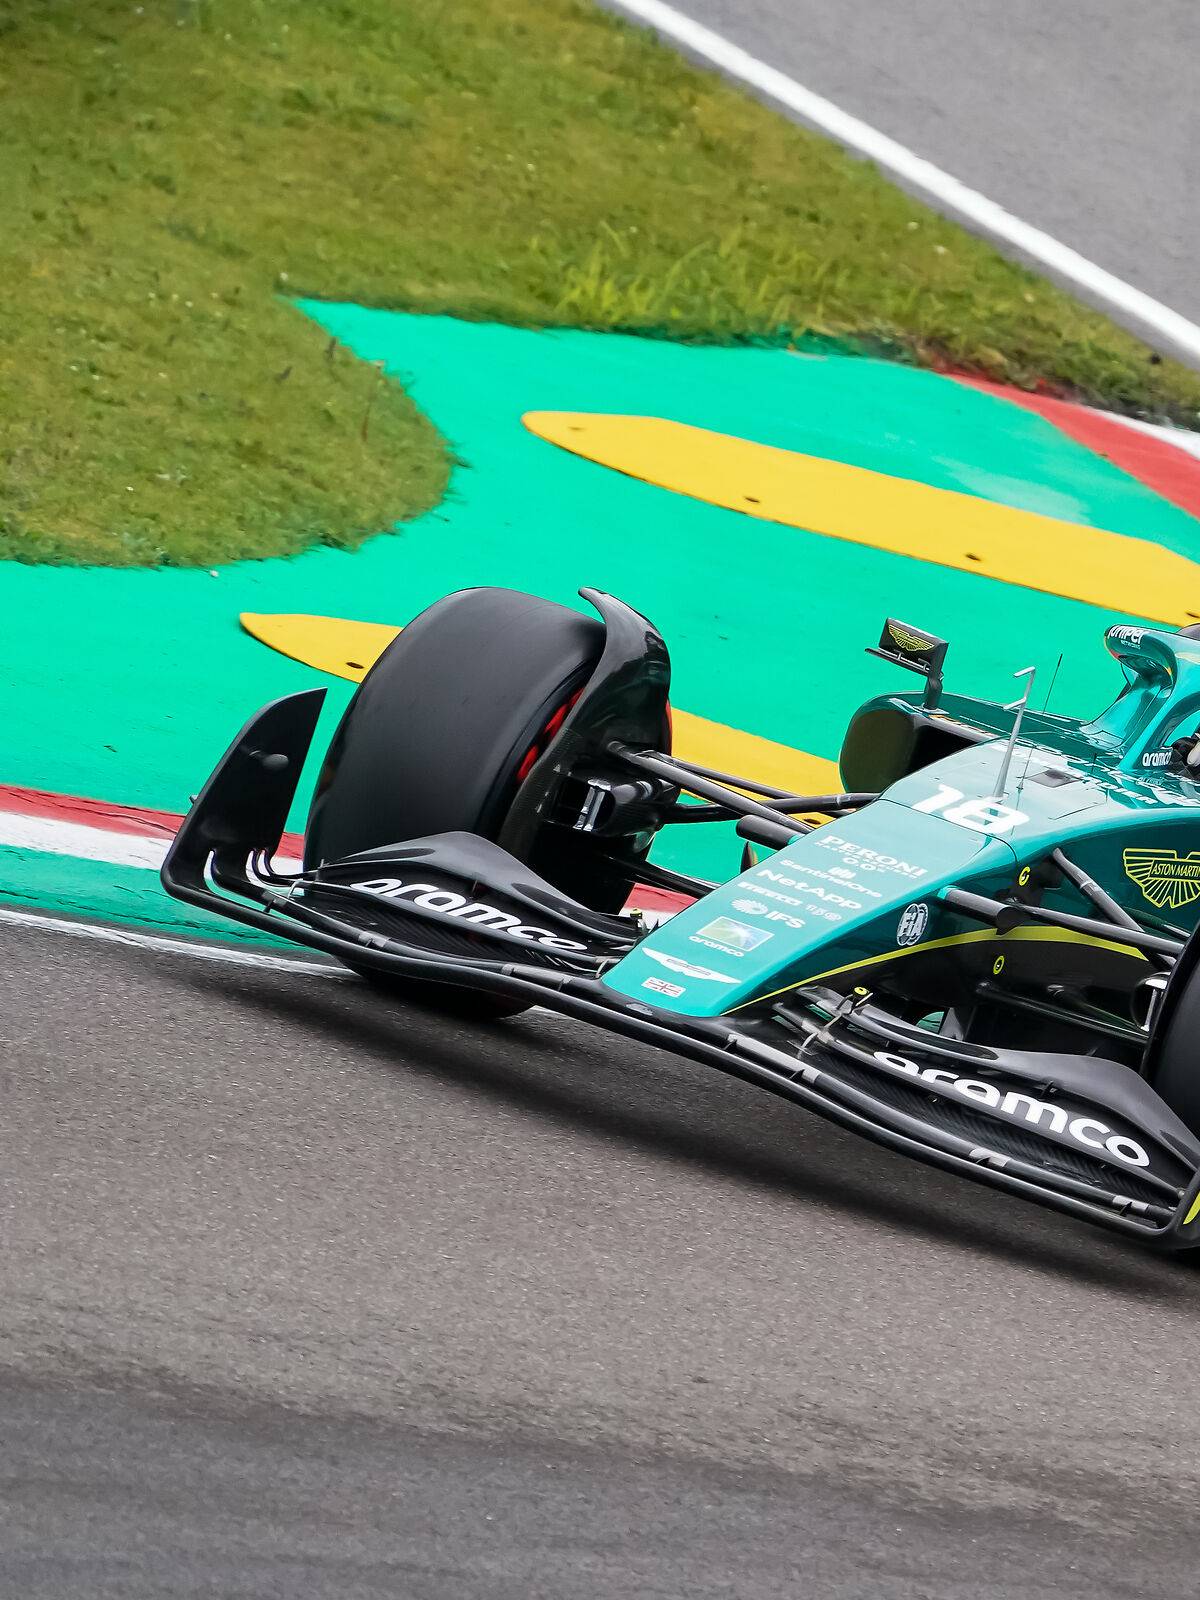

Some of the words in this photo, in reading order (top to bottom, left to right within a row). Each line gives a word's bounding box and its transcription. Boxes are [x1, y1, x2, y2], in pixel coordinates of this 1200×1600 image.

[1142, 751, 1172, 767] aramco
[910, 783, 1030, 834] 18
[819, 836, 929, 877] PERONI
[1151, 863, 1176, 876] ASTON
[756, 868, 863, 910] NetApp
[780, 859, 883, 898] SentinelOne
[349, 878, 588, 951] aramco
[765, 910, 806, 929] IFS
[689, 935, 745, 958] aramco
[873, 1050, 1150, 1167] aramco
